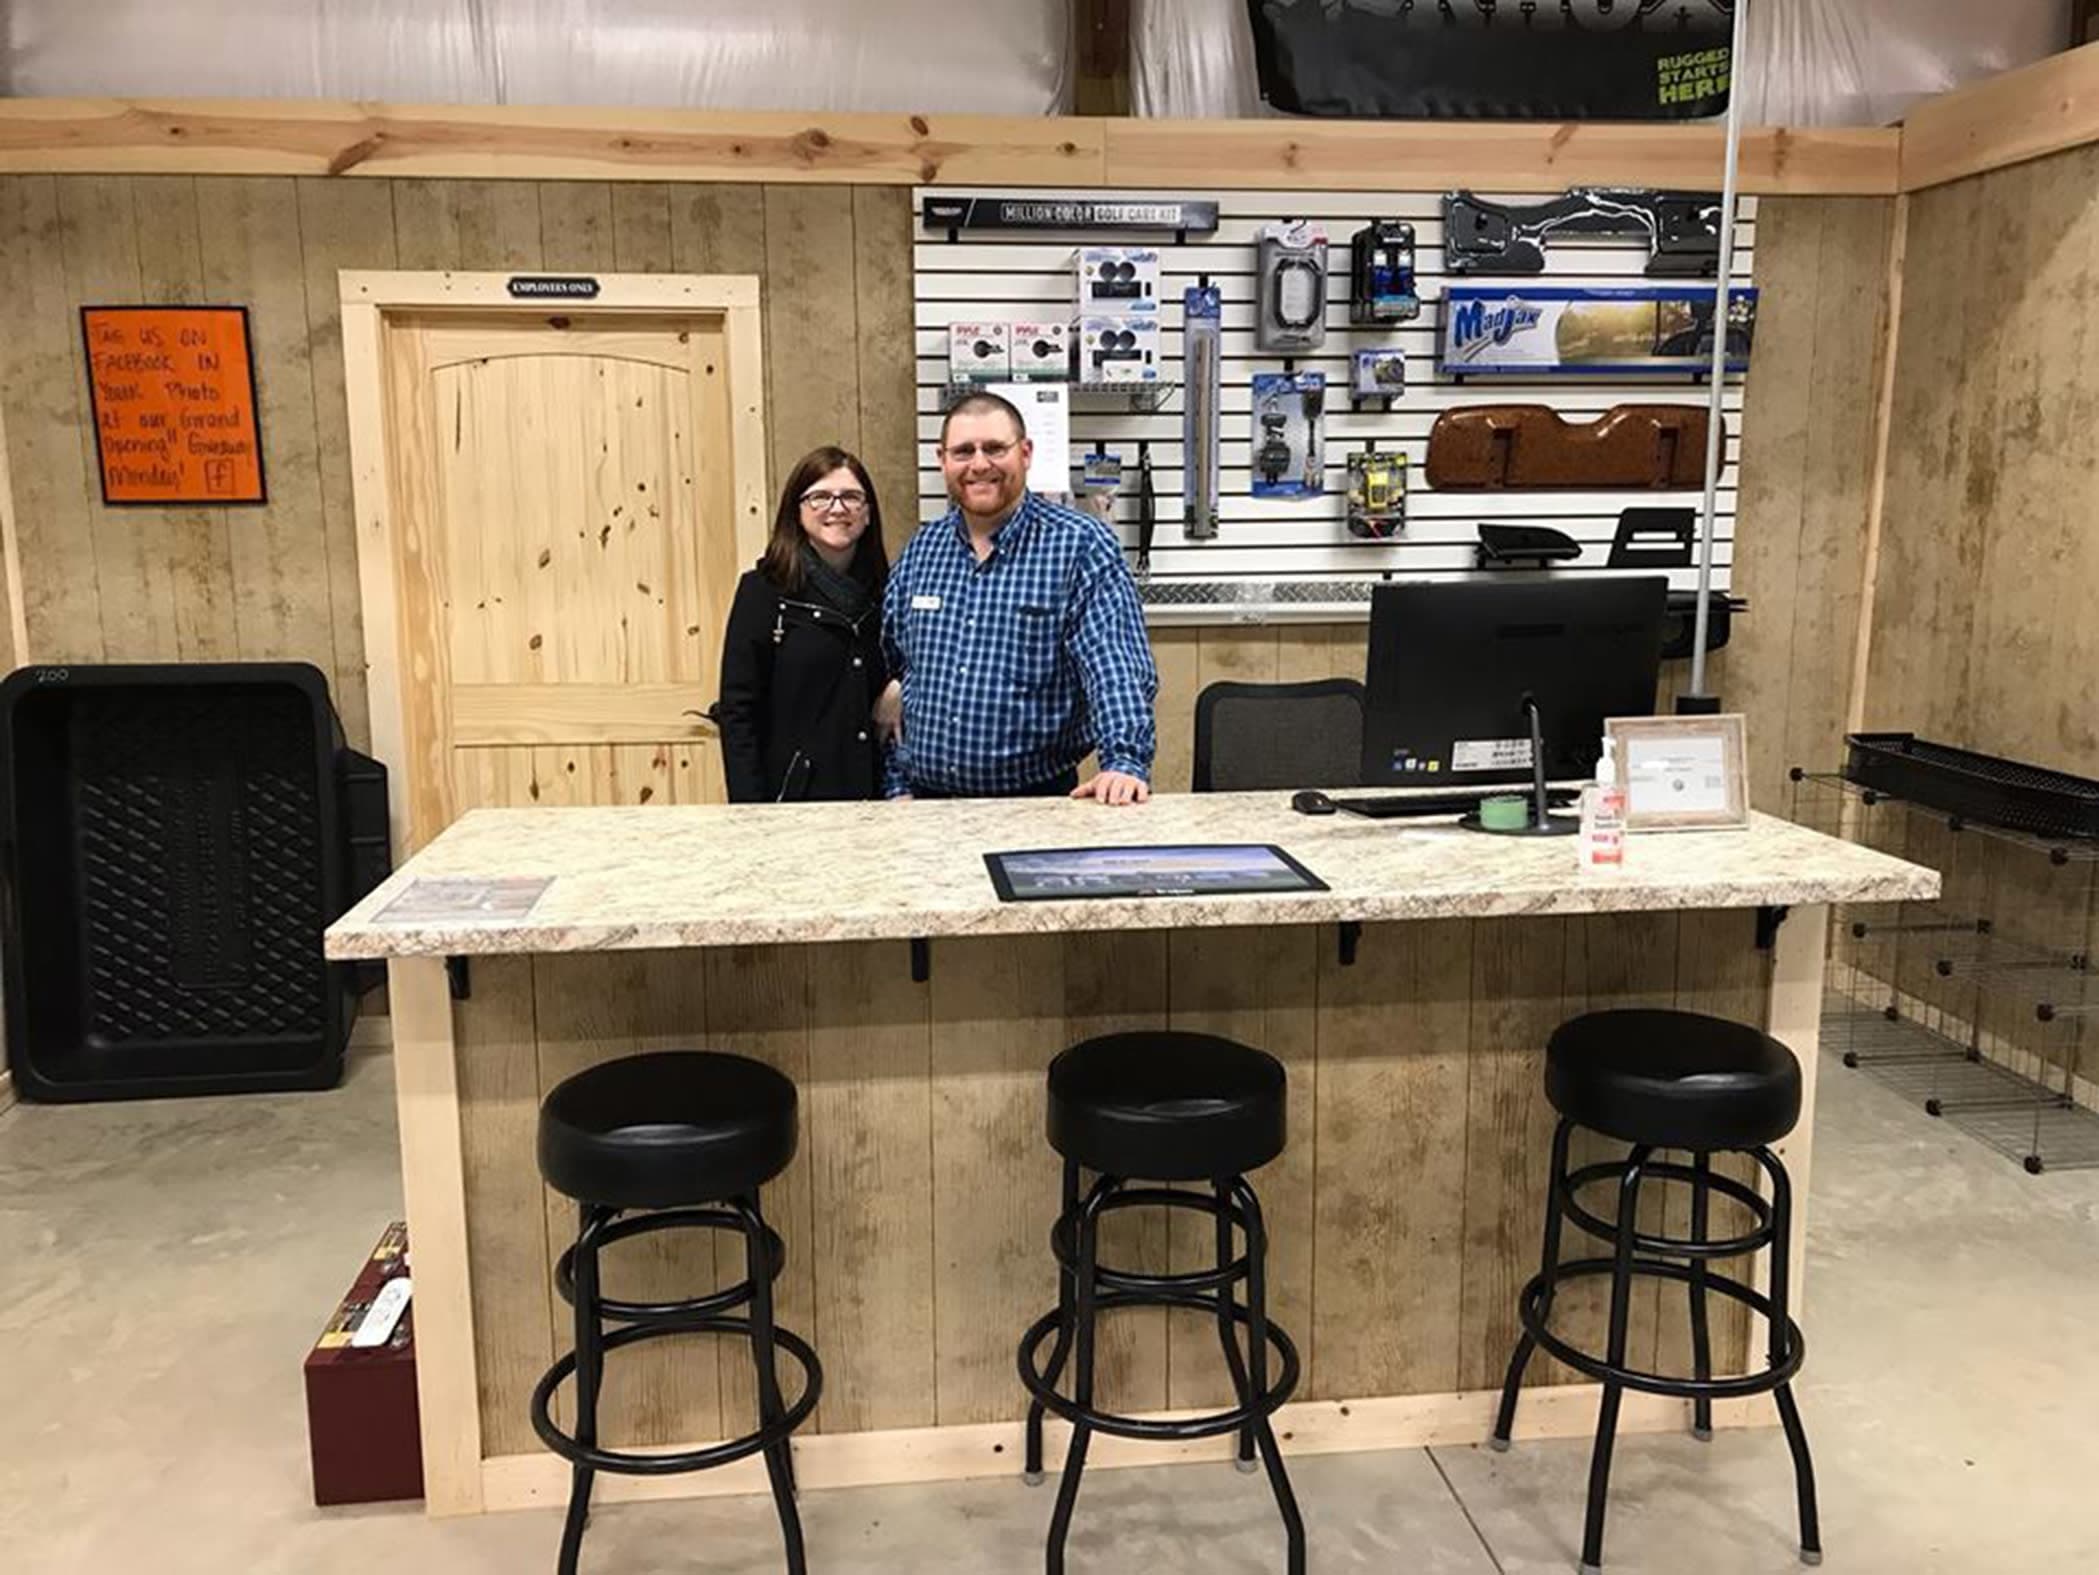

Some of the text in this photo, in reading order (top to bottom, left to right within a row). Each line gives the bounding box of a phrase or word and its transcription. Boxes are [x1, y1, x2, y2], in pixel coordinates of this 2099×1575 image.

[1657, 47, 1730, 71] RUGGED
[1659, 60, 1729, 84] STARTS
[1659, 74, 1729, 104] HERE
[1002, 205, 1052, 221] MILLION
[1055, 205, 1091, 221] COLOR
